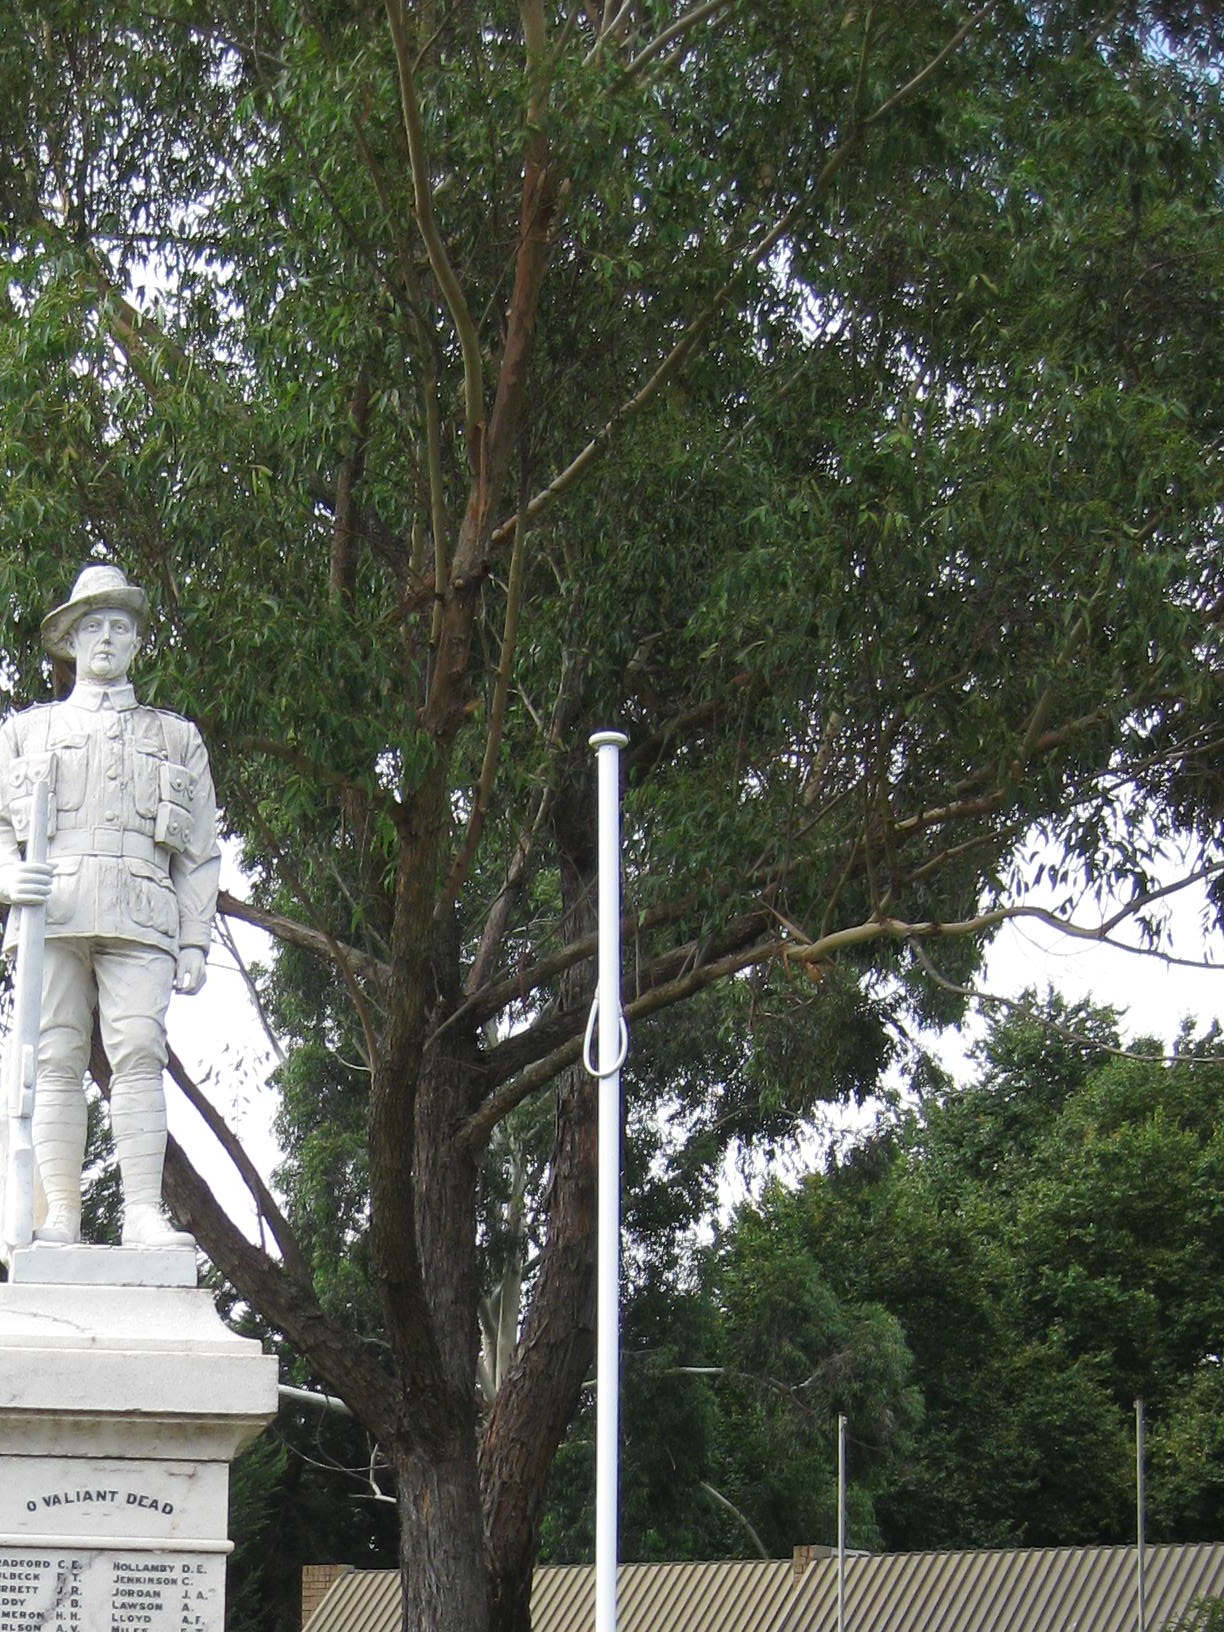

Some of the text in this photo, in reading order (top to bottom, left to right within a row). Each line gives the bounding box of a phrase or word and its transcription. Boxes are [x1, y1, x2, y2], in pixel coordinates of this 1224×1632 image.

[27, 1490, 174, 1516] O VALIANT DEAD
[112, 1588, 161, 1598] JORDAN
[112, 1600, 163, 1611] LAWSON
[111, 1613, 152, 1623] LLOYD
